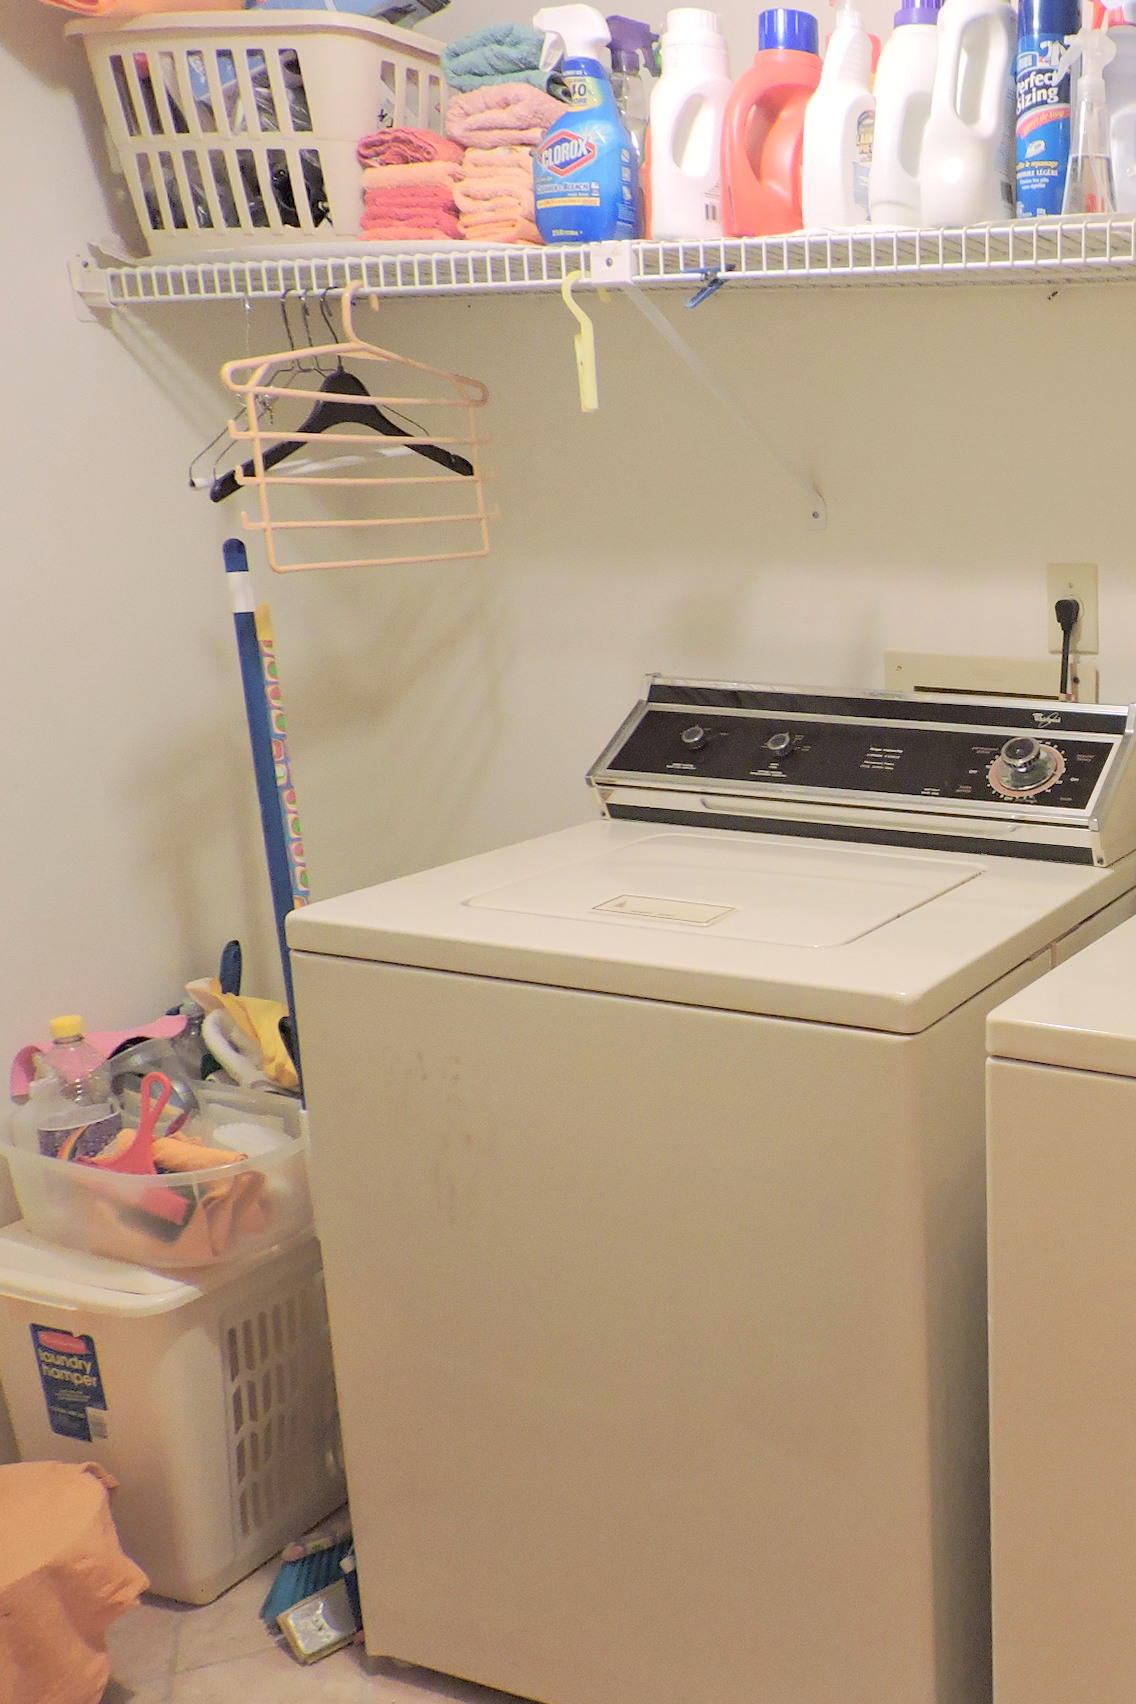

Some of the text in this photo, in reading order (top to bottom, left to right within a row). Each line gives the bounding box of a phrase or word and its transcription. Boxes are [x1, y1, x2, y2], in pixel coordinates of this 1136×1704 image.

[540, 139, 590, 168] CLOROX
[40, 1350, 92, 1374] laundry
[41, 1362, 97, 1387] hamper
